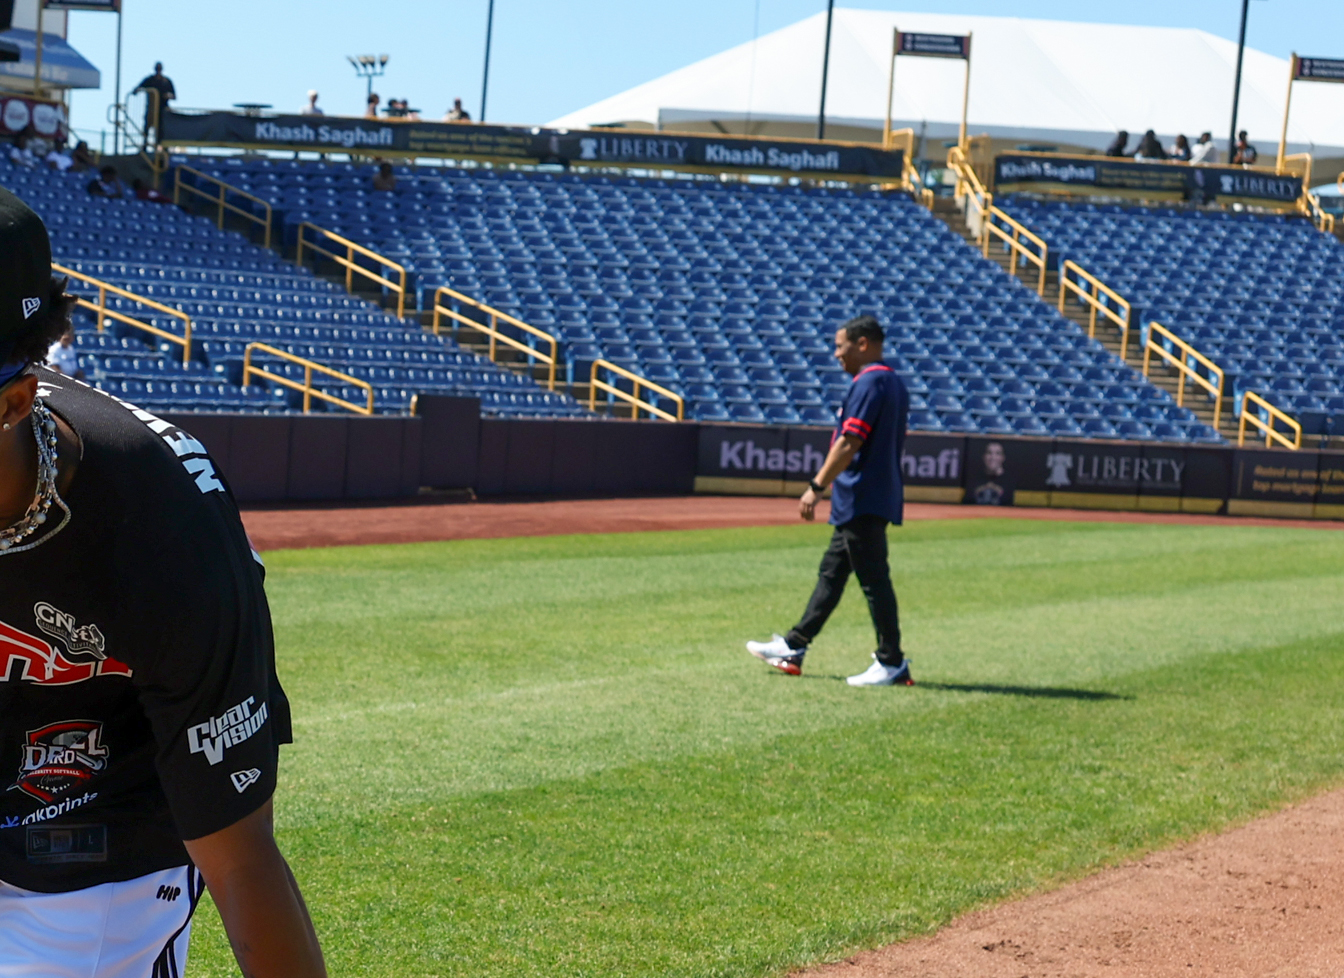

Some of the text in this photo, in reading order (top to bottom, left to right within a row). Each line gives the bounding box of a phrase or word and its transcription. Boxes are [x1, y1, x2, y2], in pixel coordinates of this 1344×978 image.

[256, 122, 314, 142] Khash
[318, 126, 394, 147] Saghafi
[600, 137, 689, 159] LIBERTY
[706, 144, 840, 170] Khash Saghafi
[1235, 175, 1298, 197] LIBERTY
[720, 440, 824, 473] Khash
[1077, 454, 1185, 482] LIBERTY
[187, 695, 255, 753] Clear
[202, 701, 268, 766] Vision
